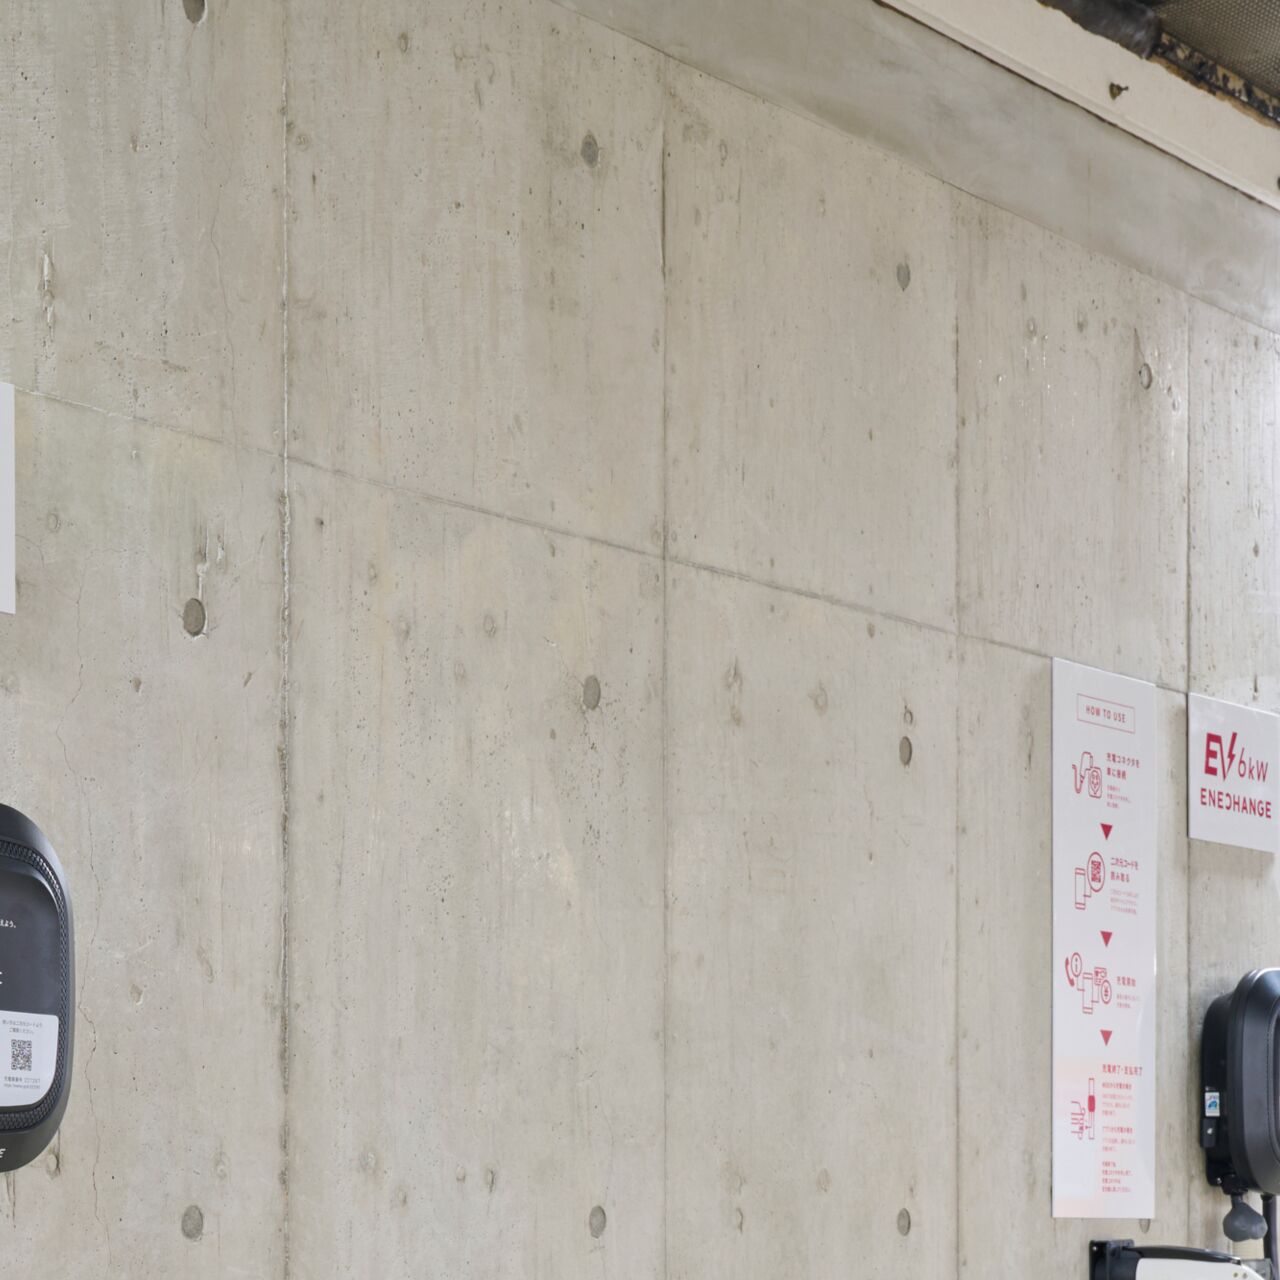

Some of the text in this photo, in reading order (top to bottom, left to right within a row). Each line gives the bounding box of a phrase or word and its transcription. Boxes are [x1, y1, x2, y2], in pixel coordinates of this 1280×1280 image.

[1085, 704, 1126, 723] HOW TO USE
[1204, 731, 1269, 782] EV 6kW
